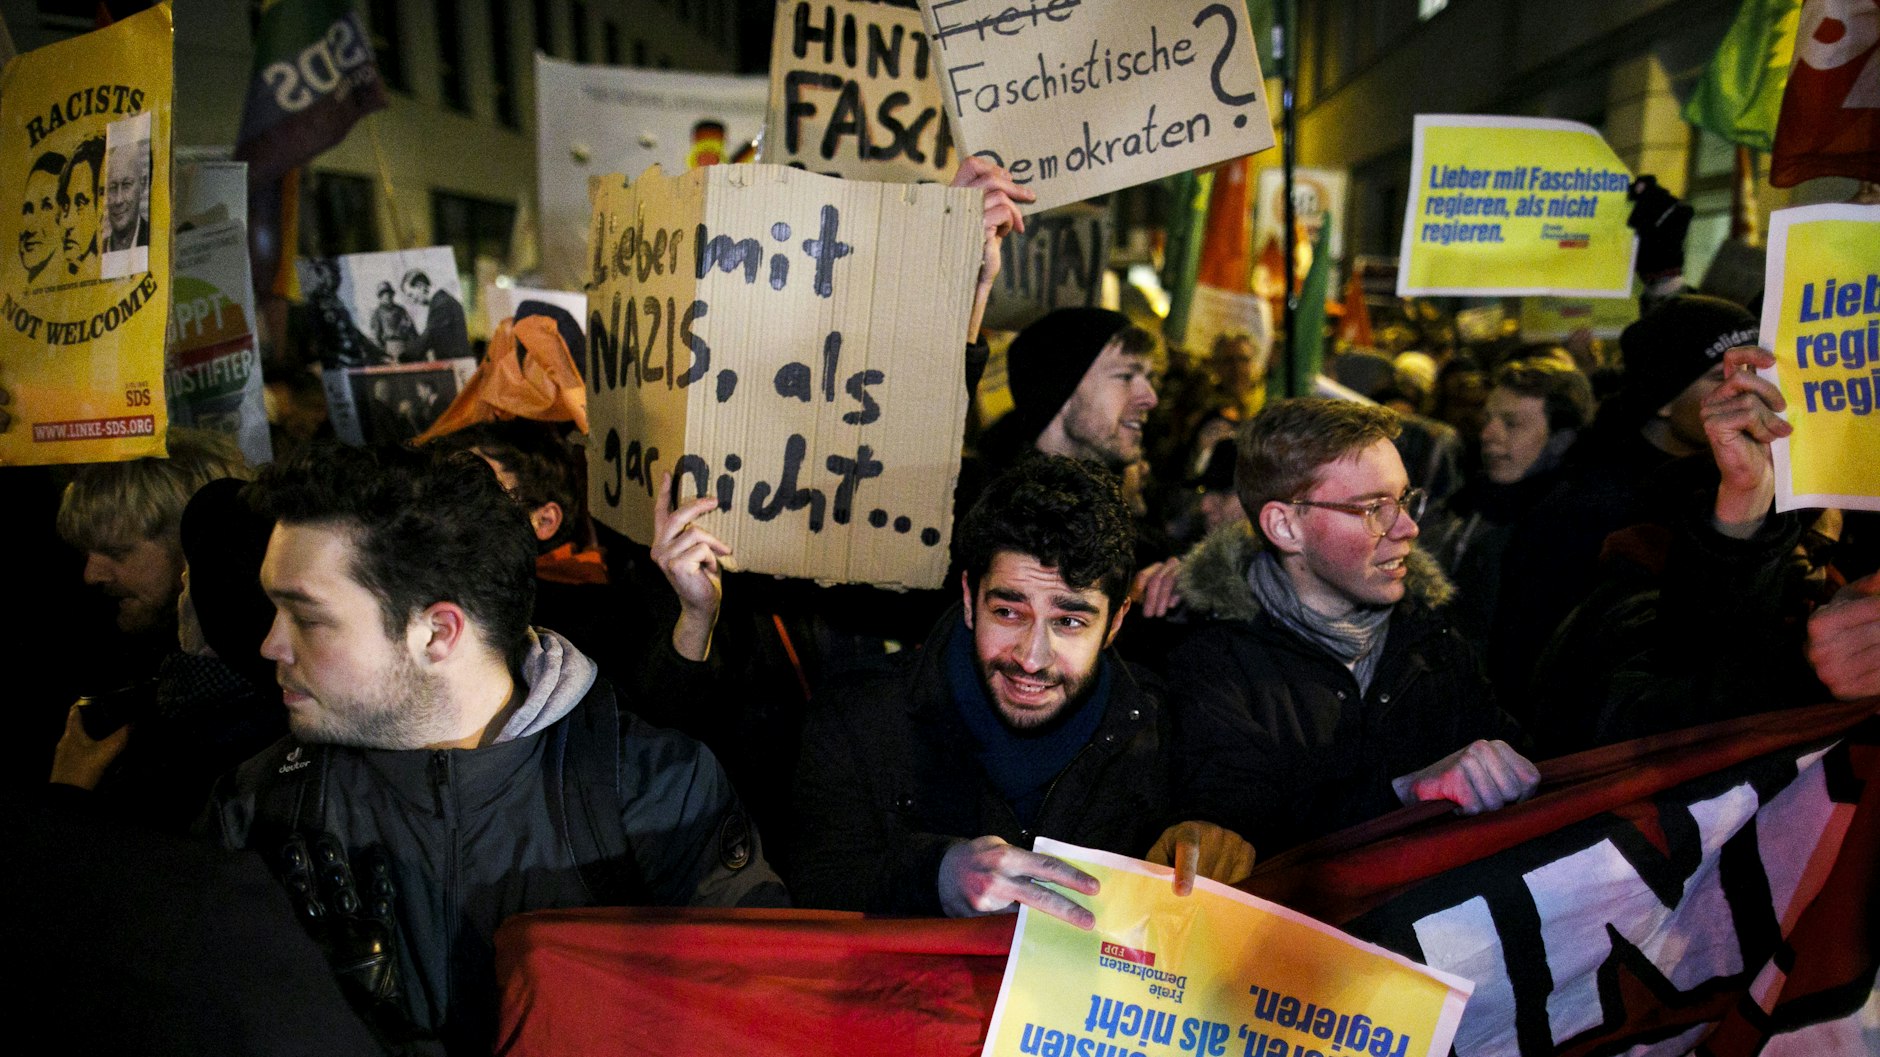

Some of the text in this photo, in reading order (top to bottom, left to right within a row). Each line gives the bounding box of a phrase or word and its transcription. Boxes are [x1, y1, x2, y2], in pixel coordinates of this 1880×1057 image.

[949, 26, 1197, 118] Faschistische
[26, 84, 145, 148] RACISTS
[1429, 164, 1630, 193] Lieber mit Faschisten
[1425, 192, 1598, 219] regieren, als nicht
[585, 203, 853, 298] Lieber mit
[1421, 220, 1504, 245] regieren.
[1, 271, 158, 346] NOT WELCOME
[590, 292, 738, 403] NAZIS,
[773, 331, 885, 425] als
[1796, 319, 1880, 370] regi
[126, 389, 151, 407] SDS
[34, 418, 153, 440] WWW.LINKE-SDS.ORG
[603, 428, 660, 507] gar
[1099, 956, 1188, 989] Demokraten
[1104, 943, 1126, 957] FDP
[1149, 984, 1185, 1004] Freie
[1085, 994, 1177, 1049] nicht
[1249, 984, 1410, 1057] regieren.
